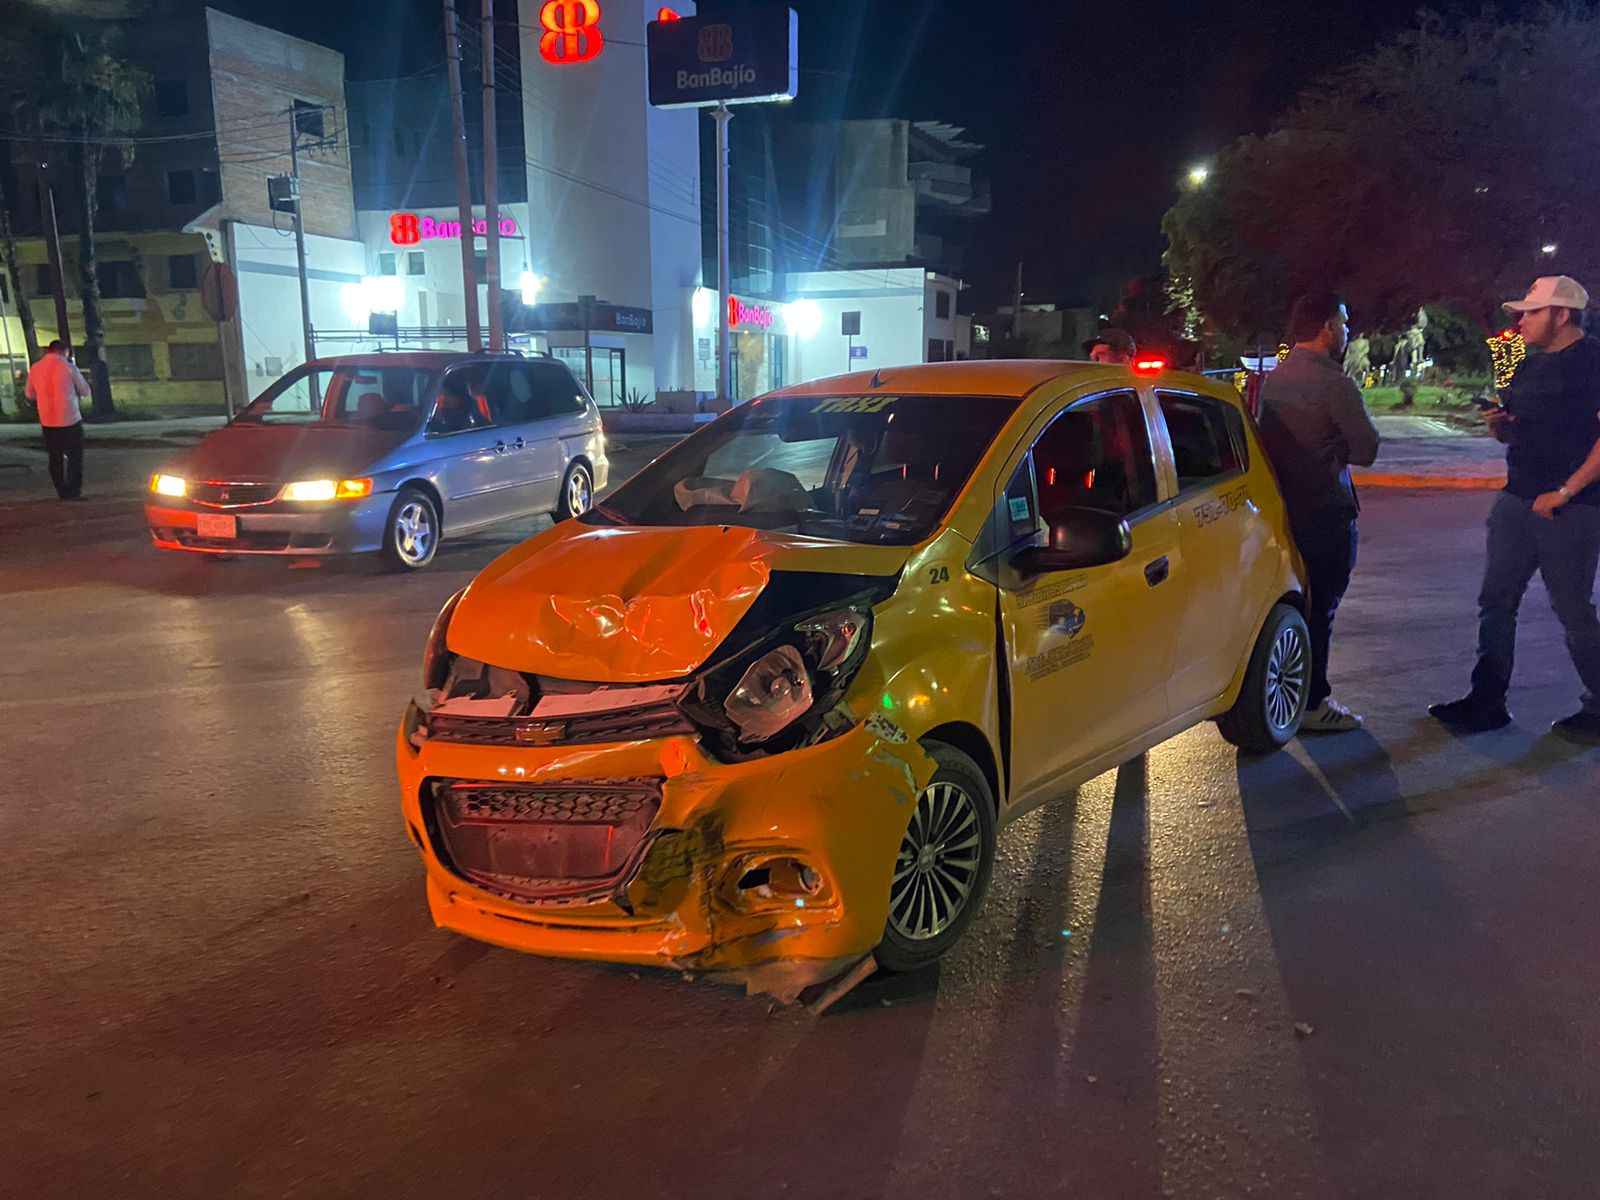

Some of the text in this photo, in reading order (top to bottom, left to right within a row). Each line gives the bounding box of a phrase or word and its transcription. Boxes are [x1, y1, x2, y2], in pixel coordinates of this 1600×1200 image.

[676, 63, 756, 90] BanBajío
[808, 396, 900, 414] TAXI
[928, 566, 950, 585] 24
